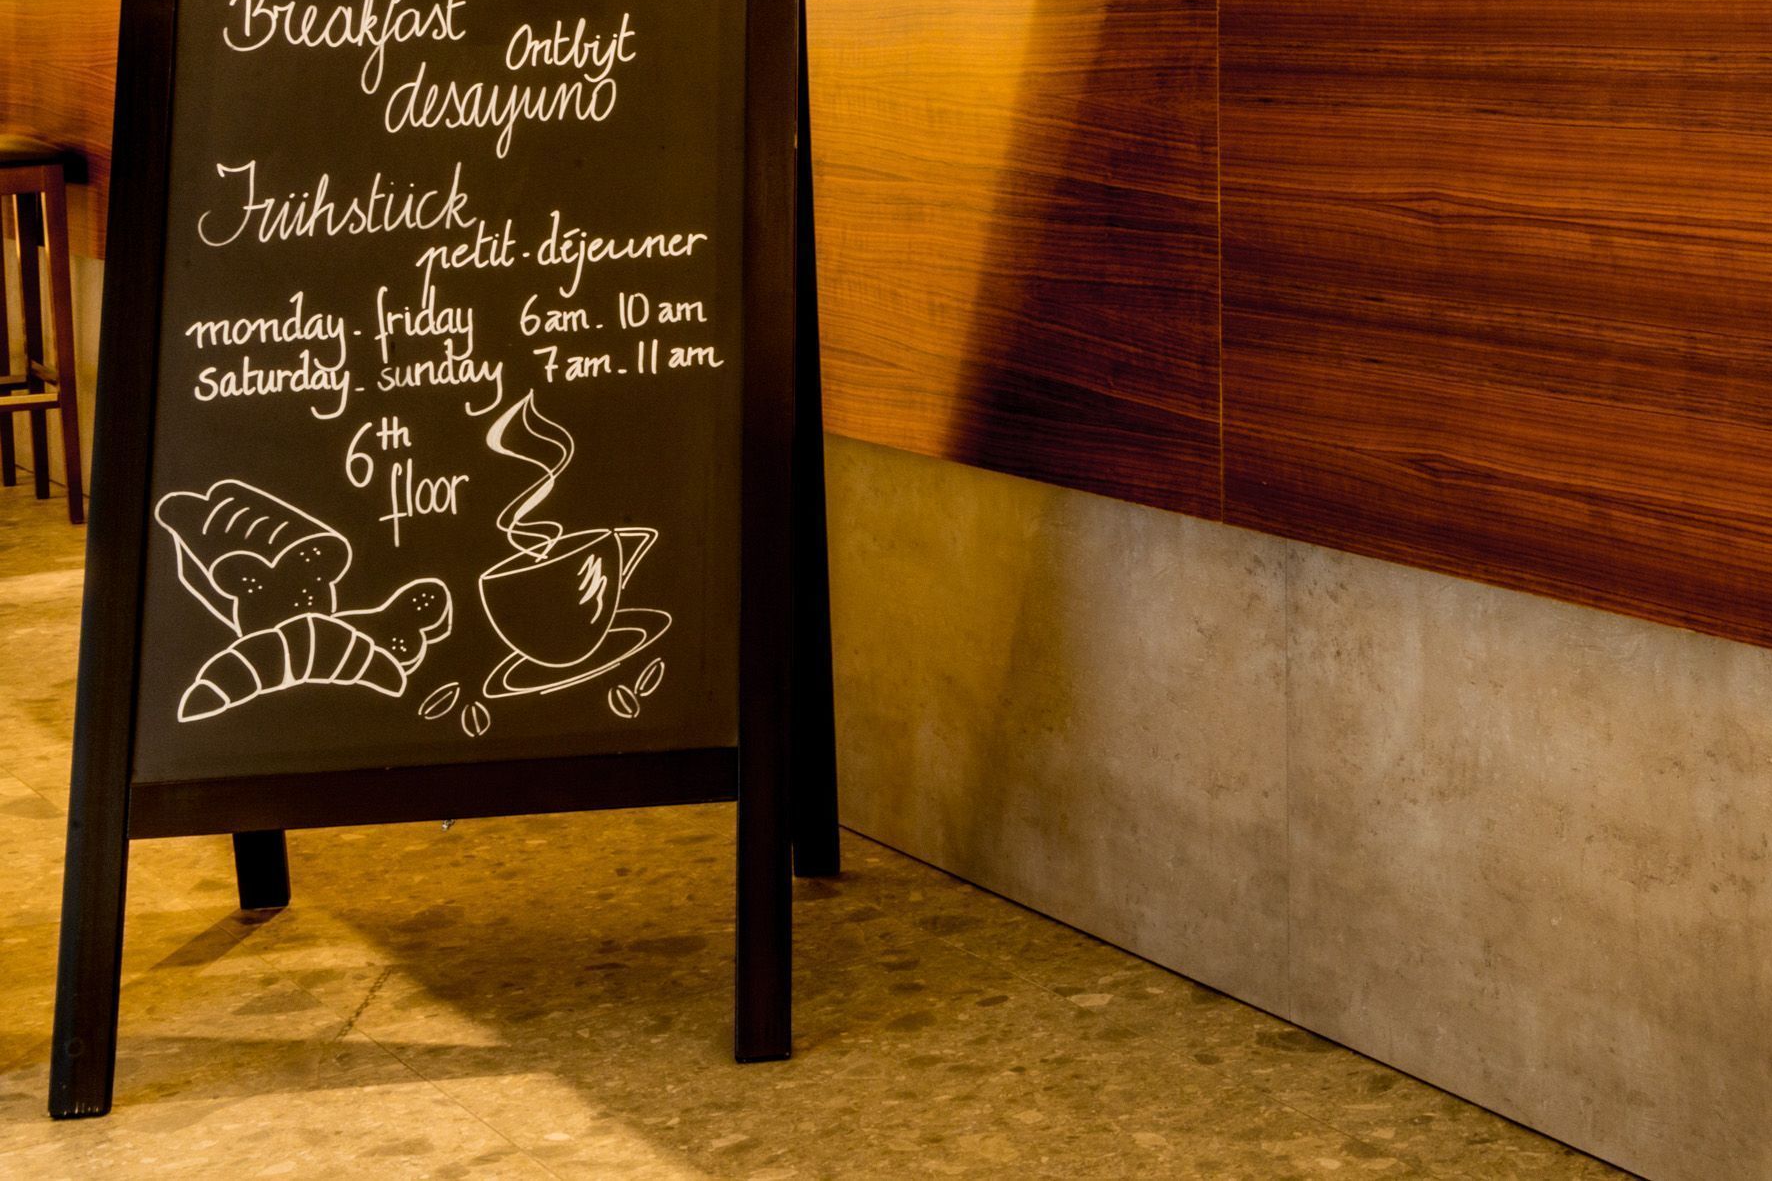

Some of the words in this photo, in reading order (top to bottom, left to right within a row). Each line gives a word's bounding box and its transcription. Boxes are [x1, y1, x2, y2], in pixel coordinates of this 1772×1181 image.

[505, 12, 637, 83] Ontbijt
[384, 61, 617, 159] desayuno
[197, 159, 477, 247] Frühstück
[184, 290, 347, 371] monday
[374, 284, 474, 364] friday
[194, 348, 351, 420] saturday
[377, 337, 504, 417] sunday
[378, 458, 470, 548] floor
